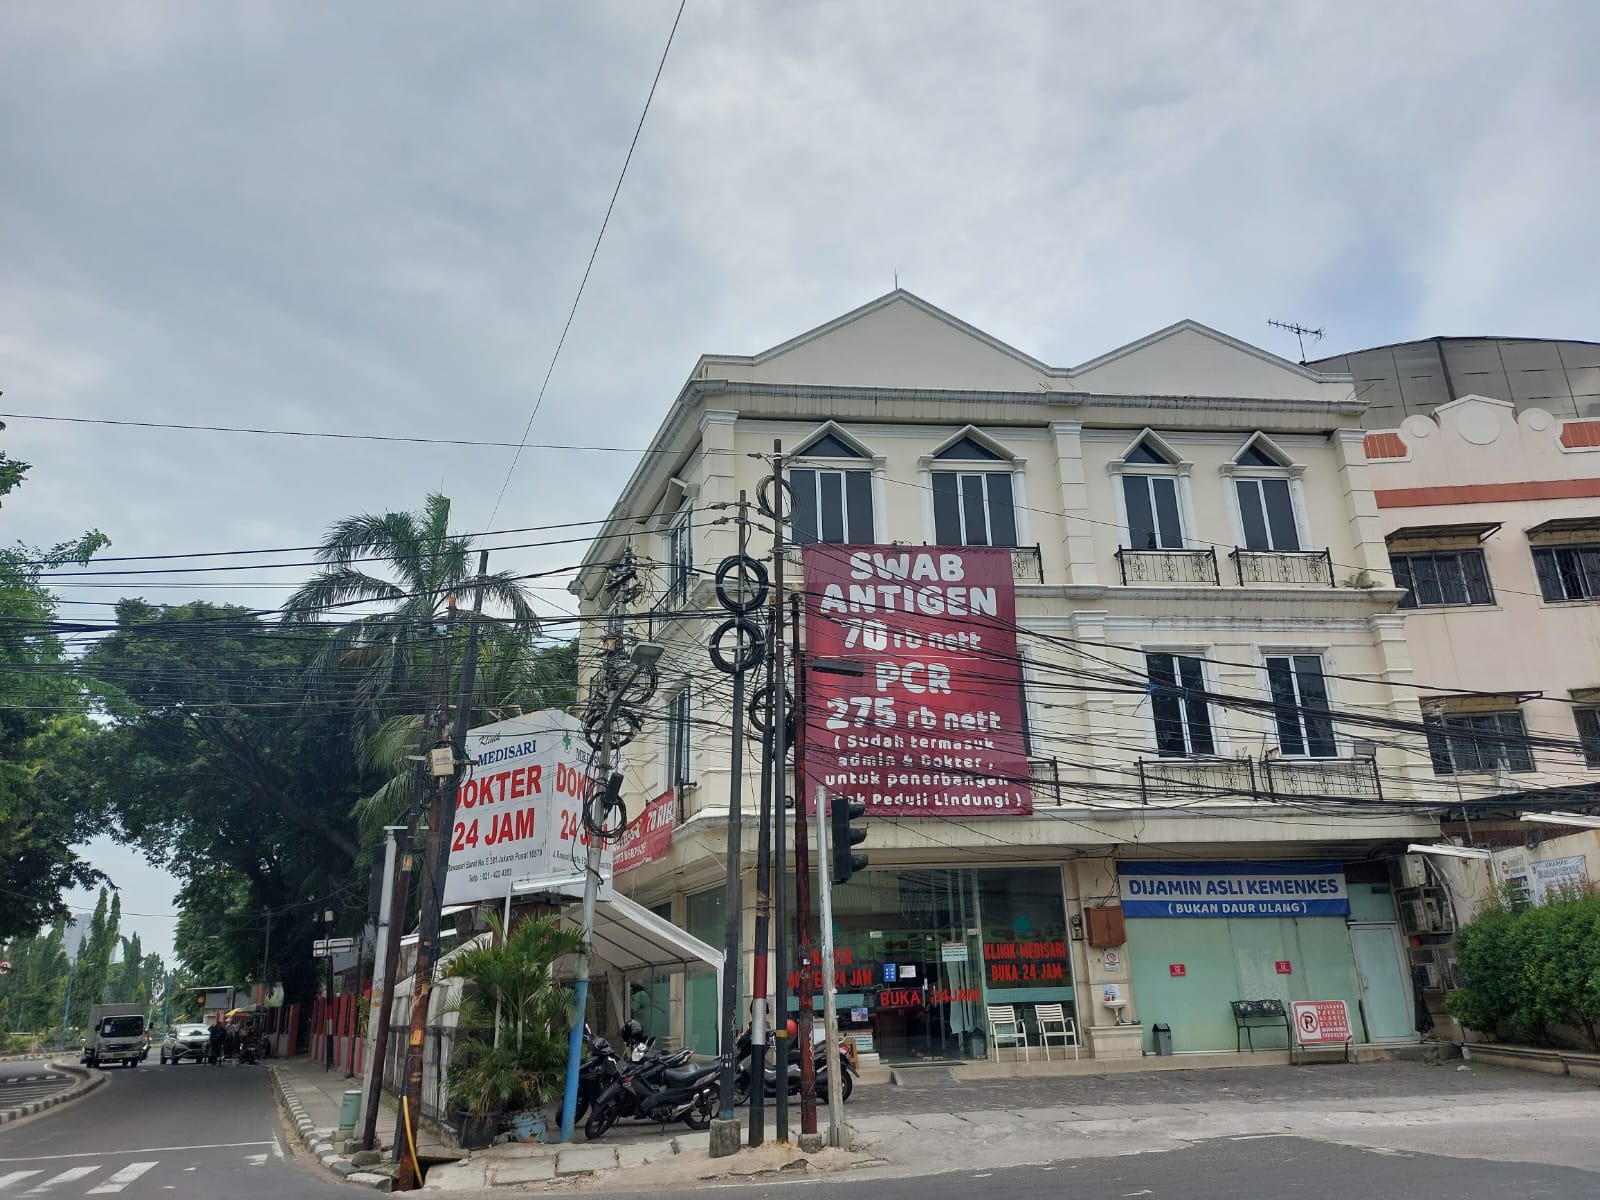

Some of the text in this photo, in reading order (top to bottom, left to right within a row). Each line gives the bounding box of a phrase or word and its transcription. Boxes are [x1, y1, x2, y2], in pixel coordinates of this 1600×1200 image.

[850, 552, 965, 582] SWAB
[820, 583, 997, 617] ANTIGEN
[844, 618, 982, 651] 70 rb nett
[876, 661, 952, 694] PCR
[825, 696, 1001, 731] 275 rb nett
[847, 734, 905, 749] Sudah
[910, 735, 995, 750] termasuk
[477, 740, 537, 767] MEDISARI
[838, 752, 896, 767] admin
[825, 771, 1009, 788] untuk penerbangan
[872, 792, 928, 806] Peduli
[934, 792, 1010, 809] Lindungi
[452, 807, 535, 852] 24 JAM
[560, 809, 577, 840] 24
[1129, 878, 1339, 896] DIJAMIN ASLI KEMENKES
[1176, 902, 1219, 913] BUKAN
[1222, 902, 1255, 913] DAUR
[1259, 902, 1300, 913] ULANG
[983, 943, 1017, 960] KLINIK
[1020, 941, 1068, 959] MEDISARI
[850, 968, 873, 987] JAM
[991, 962, 1063, 980] BUKA 24 JAM
[880, 990, 921, 1007] BUKA
